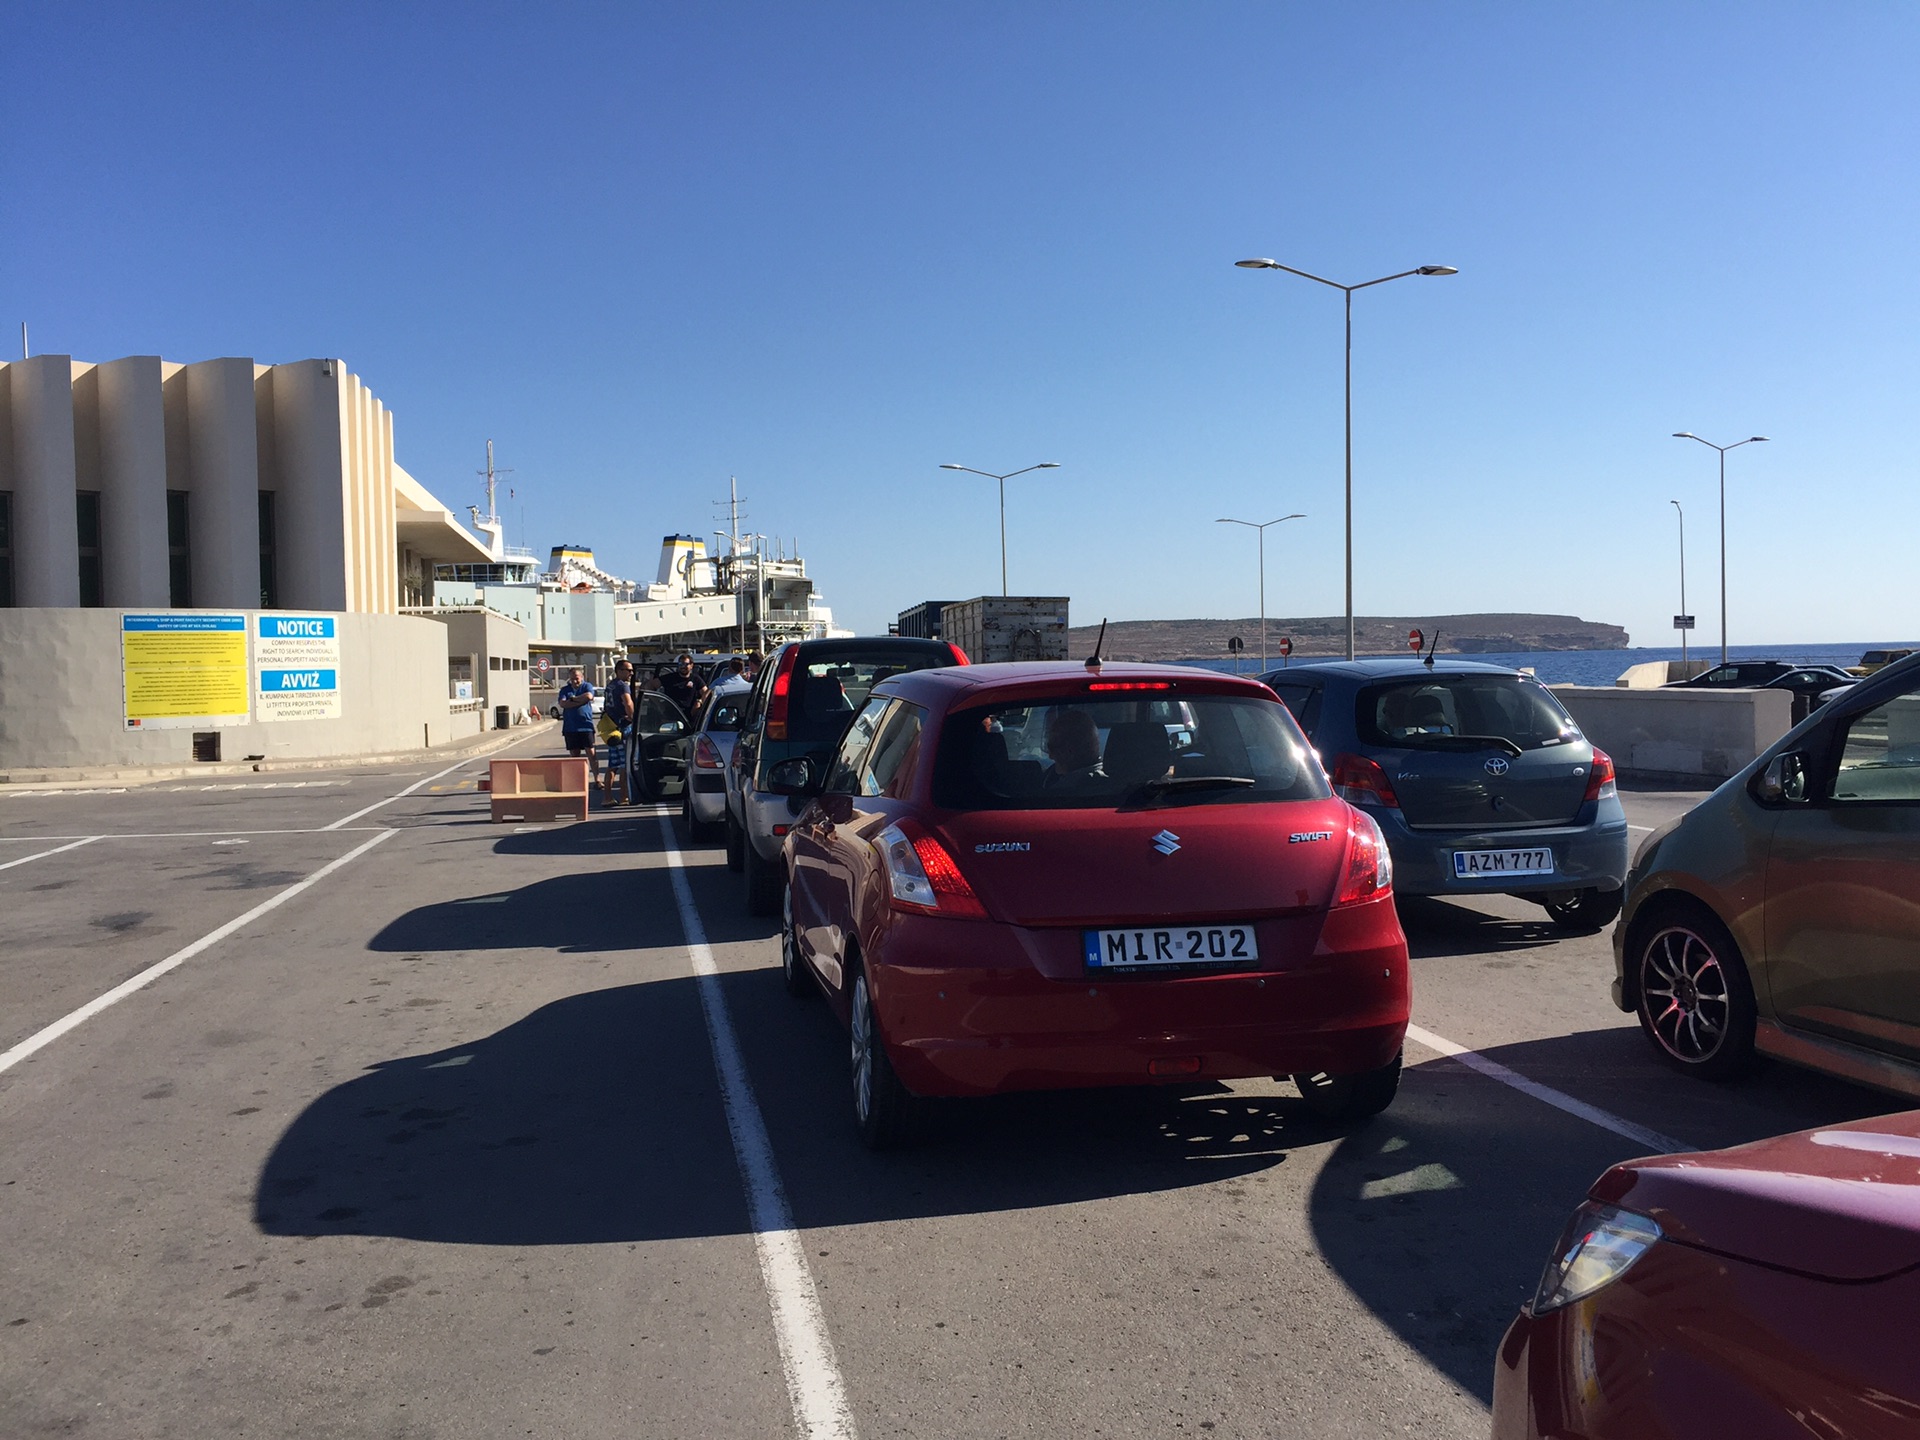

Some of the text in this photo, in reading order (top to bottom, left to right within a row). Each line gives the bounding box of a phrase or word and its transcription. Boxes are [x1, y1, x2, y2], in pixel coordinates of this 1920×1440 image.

[277, 620, 324, 636] NOTICE
[281, 671, 320, 689] AVVIŻ
[1289, 831, 1334, 844] SWIFT
[974, 841, 1031, 854] SUZUKI
[1469, 853, 1506, 871] AZM
[1511, 851, 1545, 869] 777
[1088, 928, 1248, 963] M MIR 202
